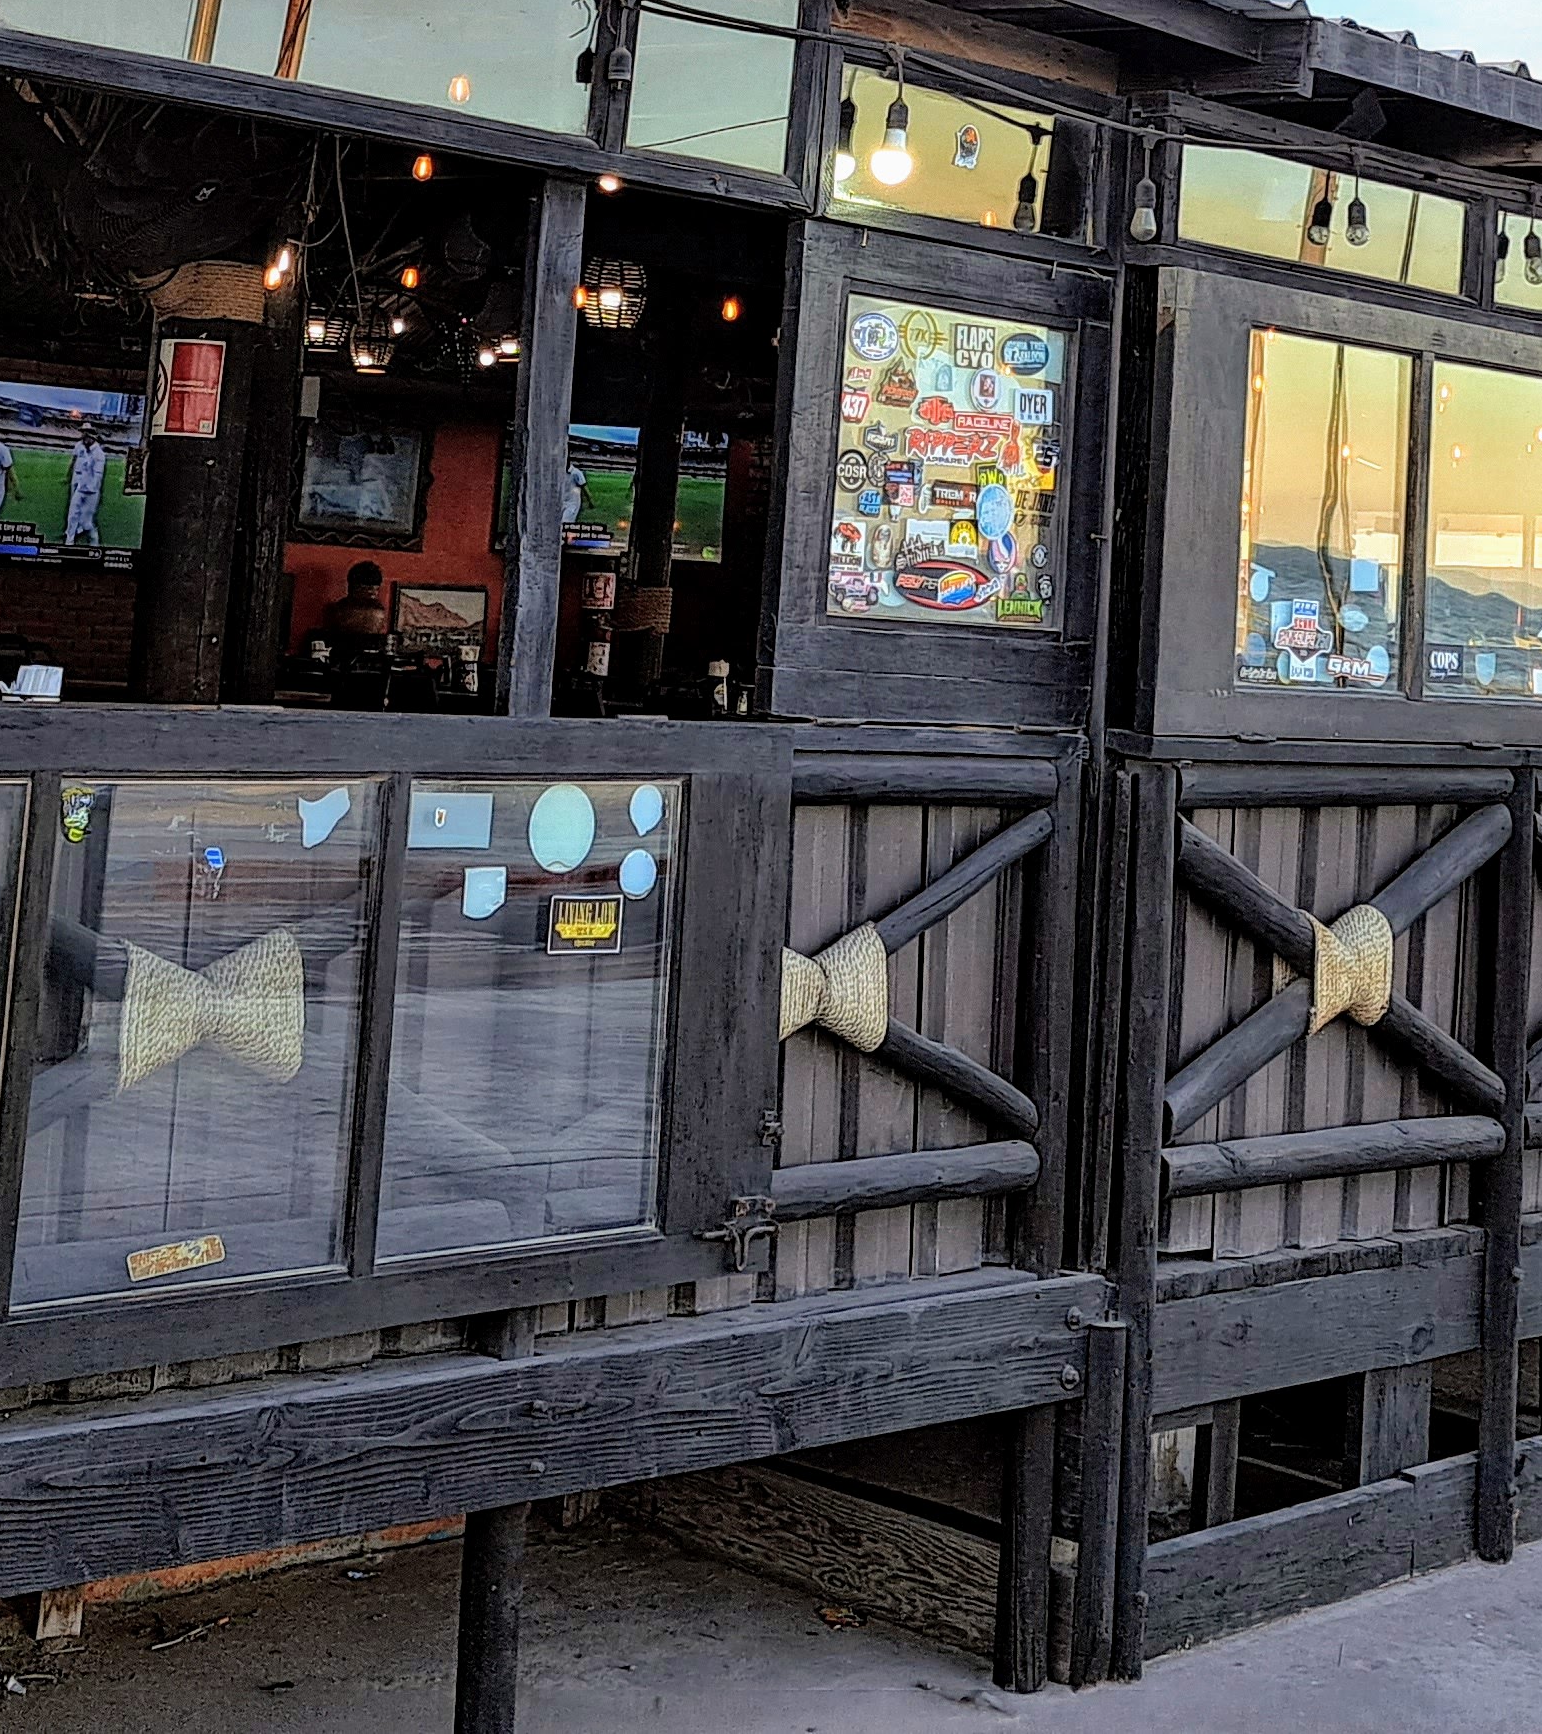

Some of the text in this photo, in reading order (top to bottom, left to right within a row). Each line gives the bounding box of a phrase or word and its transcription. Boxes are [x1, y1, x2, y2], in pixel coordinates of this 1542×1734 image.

[956, 325, 995, 352] FLAPS
[1019, 392, 1048, 415] DYER
[957, 416, 1011, 430] RACELINE
[1328, 657, 1372, 677] G&M
[1429, 650, 1460, 670] COPS
